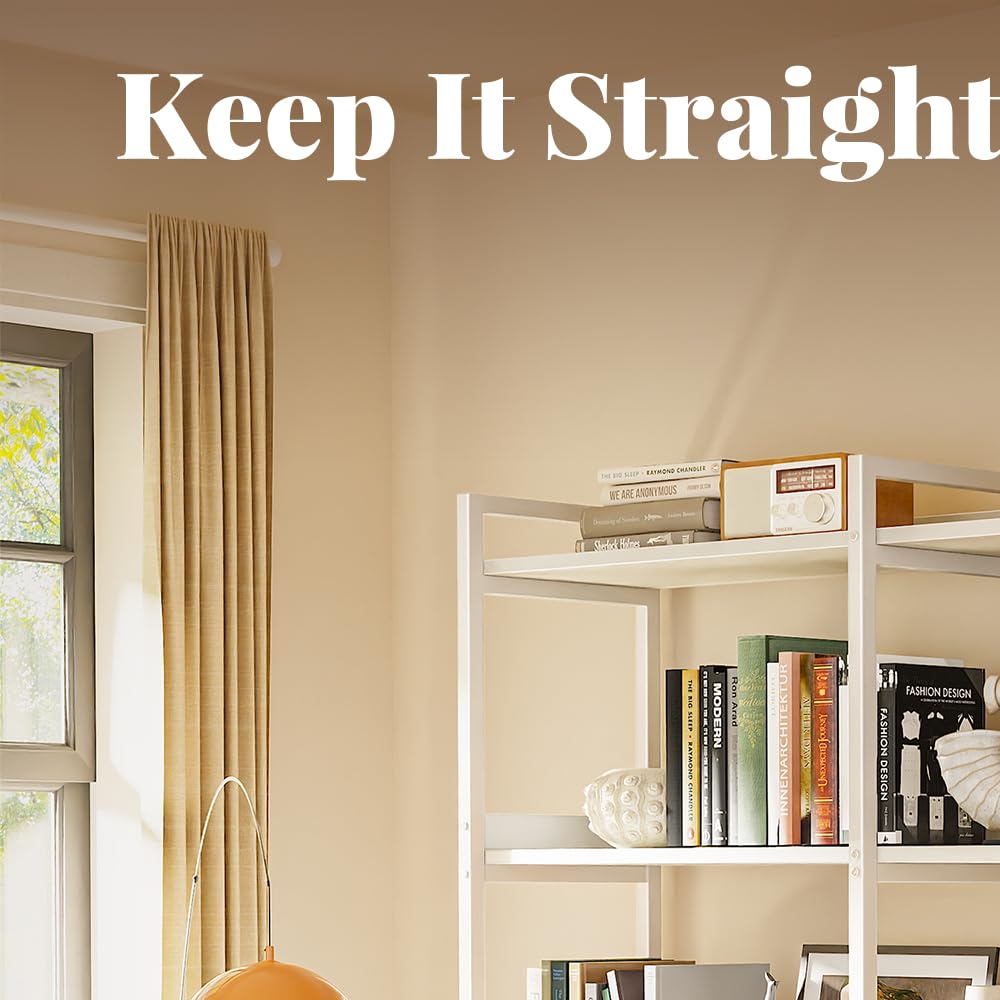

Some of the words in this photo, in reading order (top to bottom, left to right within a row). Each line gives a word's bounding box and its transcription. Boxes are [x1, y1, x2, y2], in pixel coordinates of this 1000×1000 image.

[646, 467, 675, 476] RAYMOND
[676, 465, 707, 474] CHANDLER
[609, 490, 621, 501] WE
[621, 489, 634, 500] ARE
[635, 484, 678, 498] ANONYMOUS
[906, 685, 941, 697] FASHION
[942, 687, 972, 699] DESIGN
[713, 682, 722, 749] MODERN
[880, 708, 889, 756] FASHION
[779, 663, 789, 816] INNENARCHITEKTUR
[880, 760, 889, 801] DESIGN
